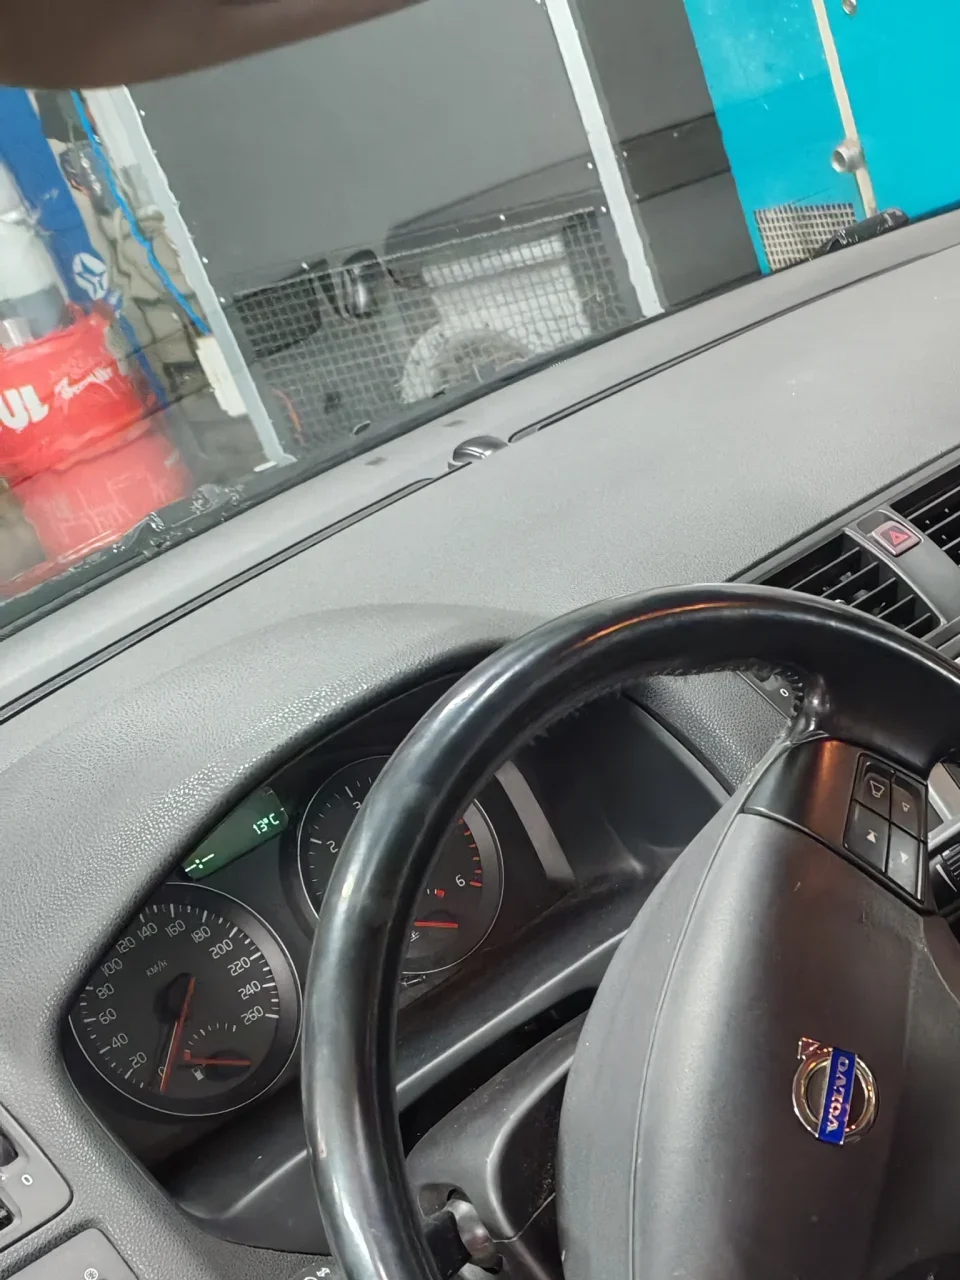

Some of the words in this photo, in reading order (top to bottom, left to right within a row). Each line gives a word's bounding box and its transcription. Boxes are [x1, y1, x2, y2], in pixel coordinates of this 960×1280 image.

[326, 840, 339, 854] 2
[454, 874, 466, 887] 6
[137, 922, 158, 941] 140
[165, 919, 186, 938] 160
[190, 926, 211, 944] 180
[115, 936, 136, 955] 120
[208, 938, 234, 960] 200
[101, 957, 123, 978] 100
[227, 956, 251, 977] 220
[96, 983, 115, 999] 80
[237, 980, 261, 1001] 240
[99, 1008, 117, 1026] 60
[240, 1006, 265, 1026] 260
[111, 1032, 129, 1049] 40
[129, 1052, 147, 1069] 20
[826, 1056, 849, 1134] VOLVO
